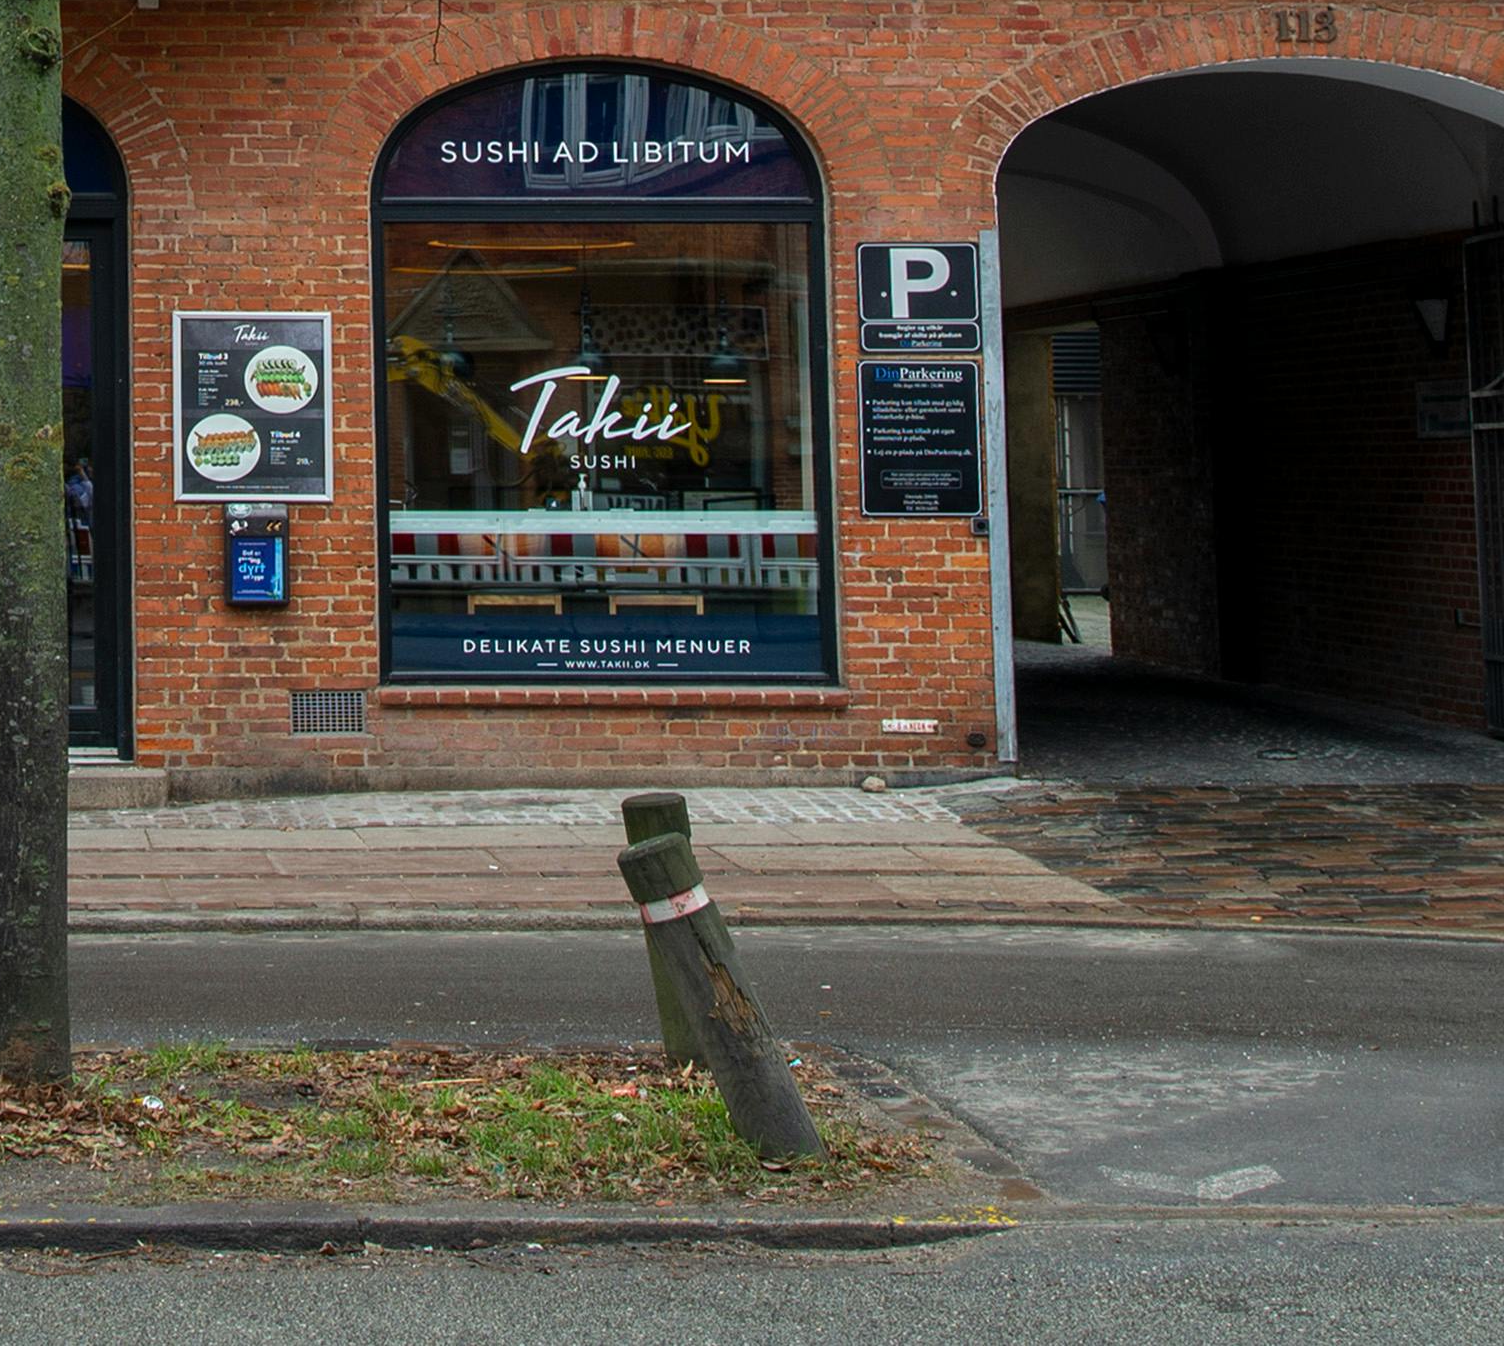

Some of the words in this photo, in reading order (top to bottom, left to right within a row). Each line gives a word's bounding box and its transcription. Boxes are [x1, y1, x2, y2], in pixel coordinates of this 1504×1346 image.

[1275, 9, 1338, 44] 113
[441, 140, 540, 164] SUSHI
[552, 140, 600, 164] AD
[612, 140, 751, 164] LIBITUM
[889, 247, 951, 319] P
[233, 324, 270, 343] Takii
[874, 367, 964, 383] DinParkering
[510, 365, 692, 454] Takii
[570, 455, 637, 470] SUSHI
[238, 563, 266, 575] dyrt
[463, 639, 572, 654] DELIKATE
[579, 639, 647, 654] SUSHI
[656, 639, 751, 654] MENUER
[564, 659, 651, 669] WWW.TAKII.DK
